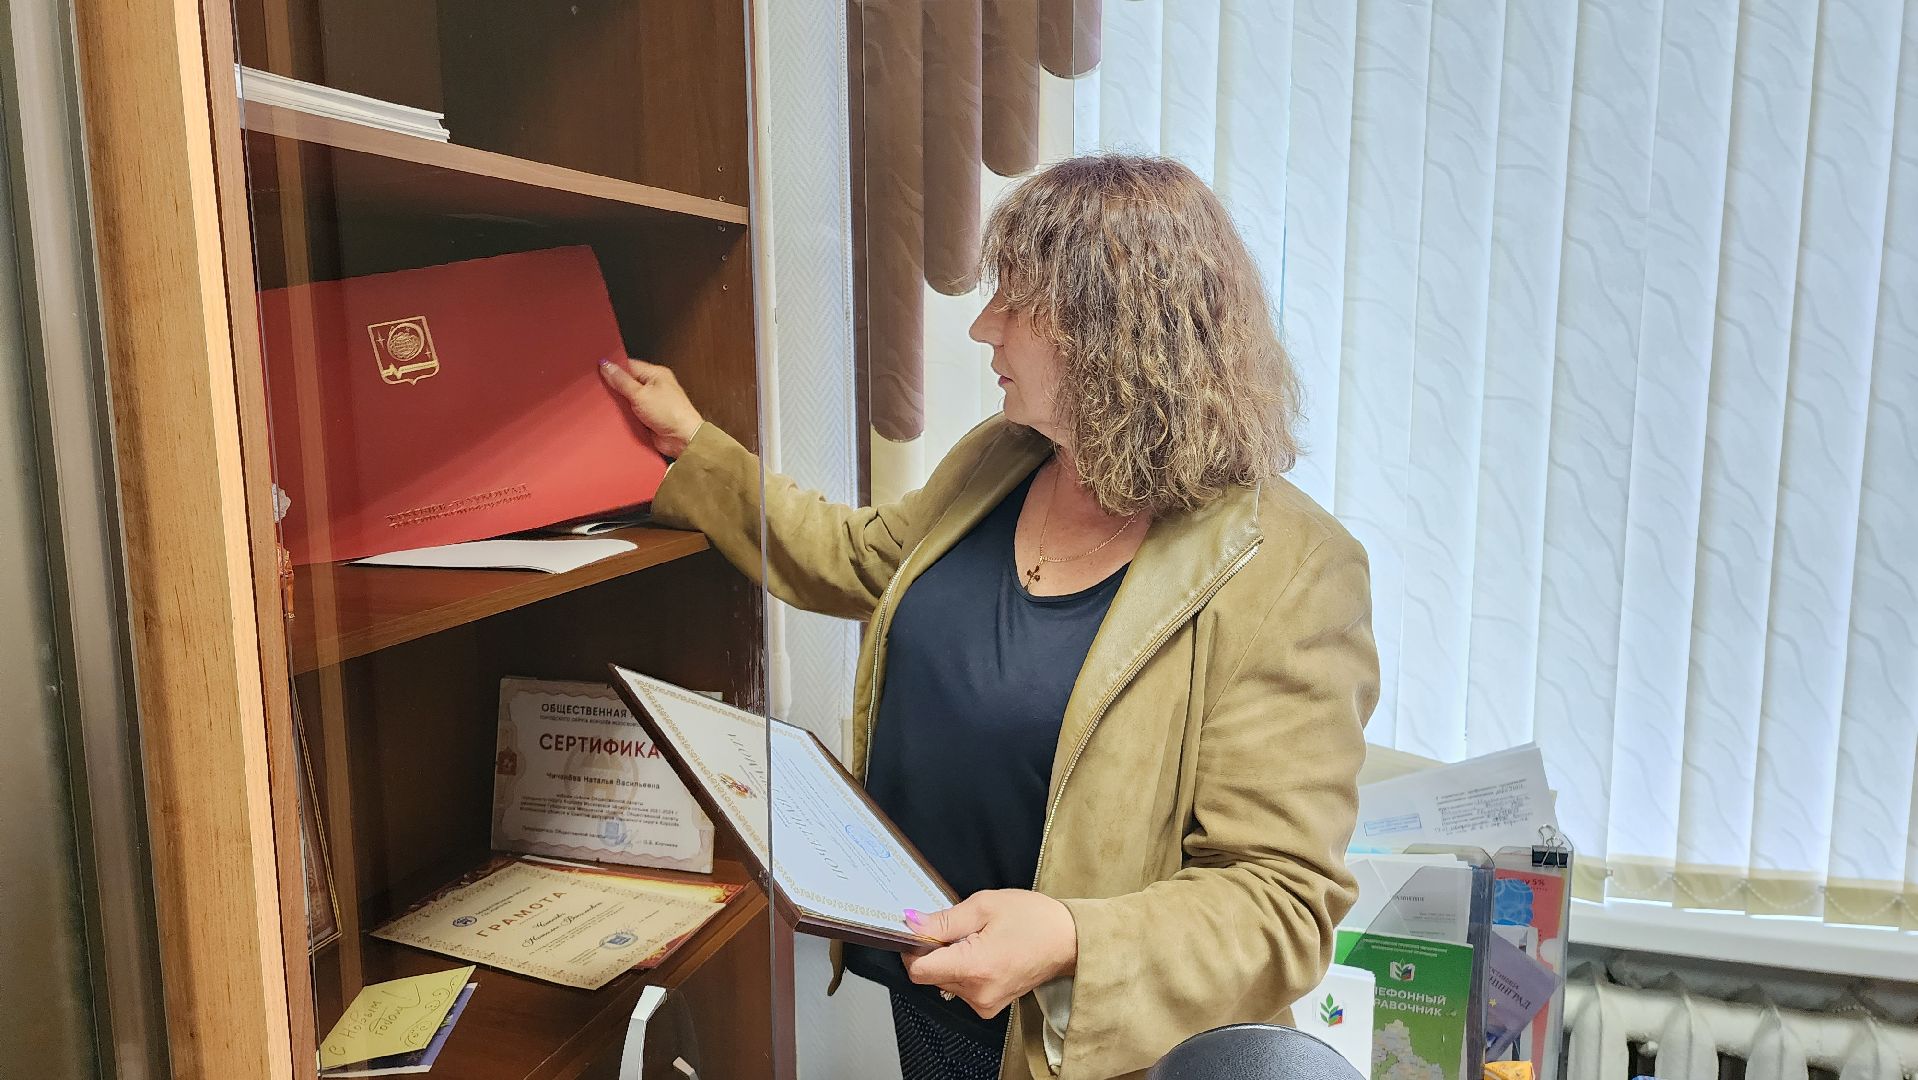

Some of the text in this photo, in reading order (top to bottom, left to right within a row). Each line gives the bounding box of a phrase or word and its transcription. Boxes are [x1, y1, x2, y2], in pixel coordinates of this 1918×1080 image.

[541, 703, 627, 718] ОБЩЕСТВЕННАЯ
[539, 733, 660, 759] СЕРТИФИКА
[584, 777, 614, 785] Наталья
[616, 778, 660, 789] Васильевна
[476, 891, 567, 938] ГРАМОТА
